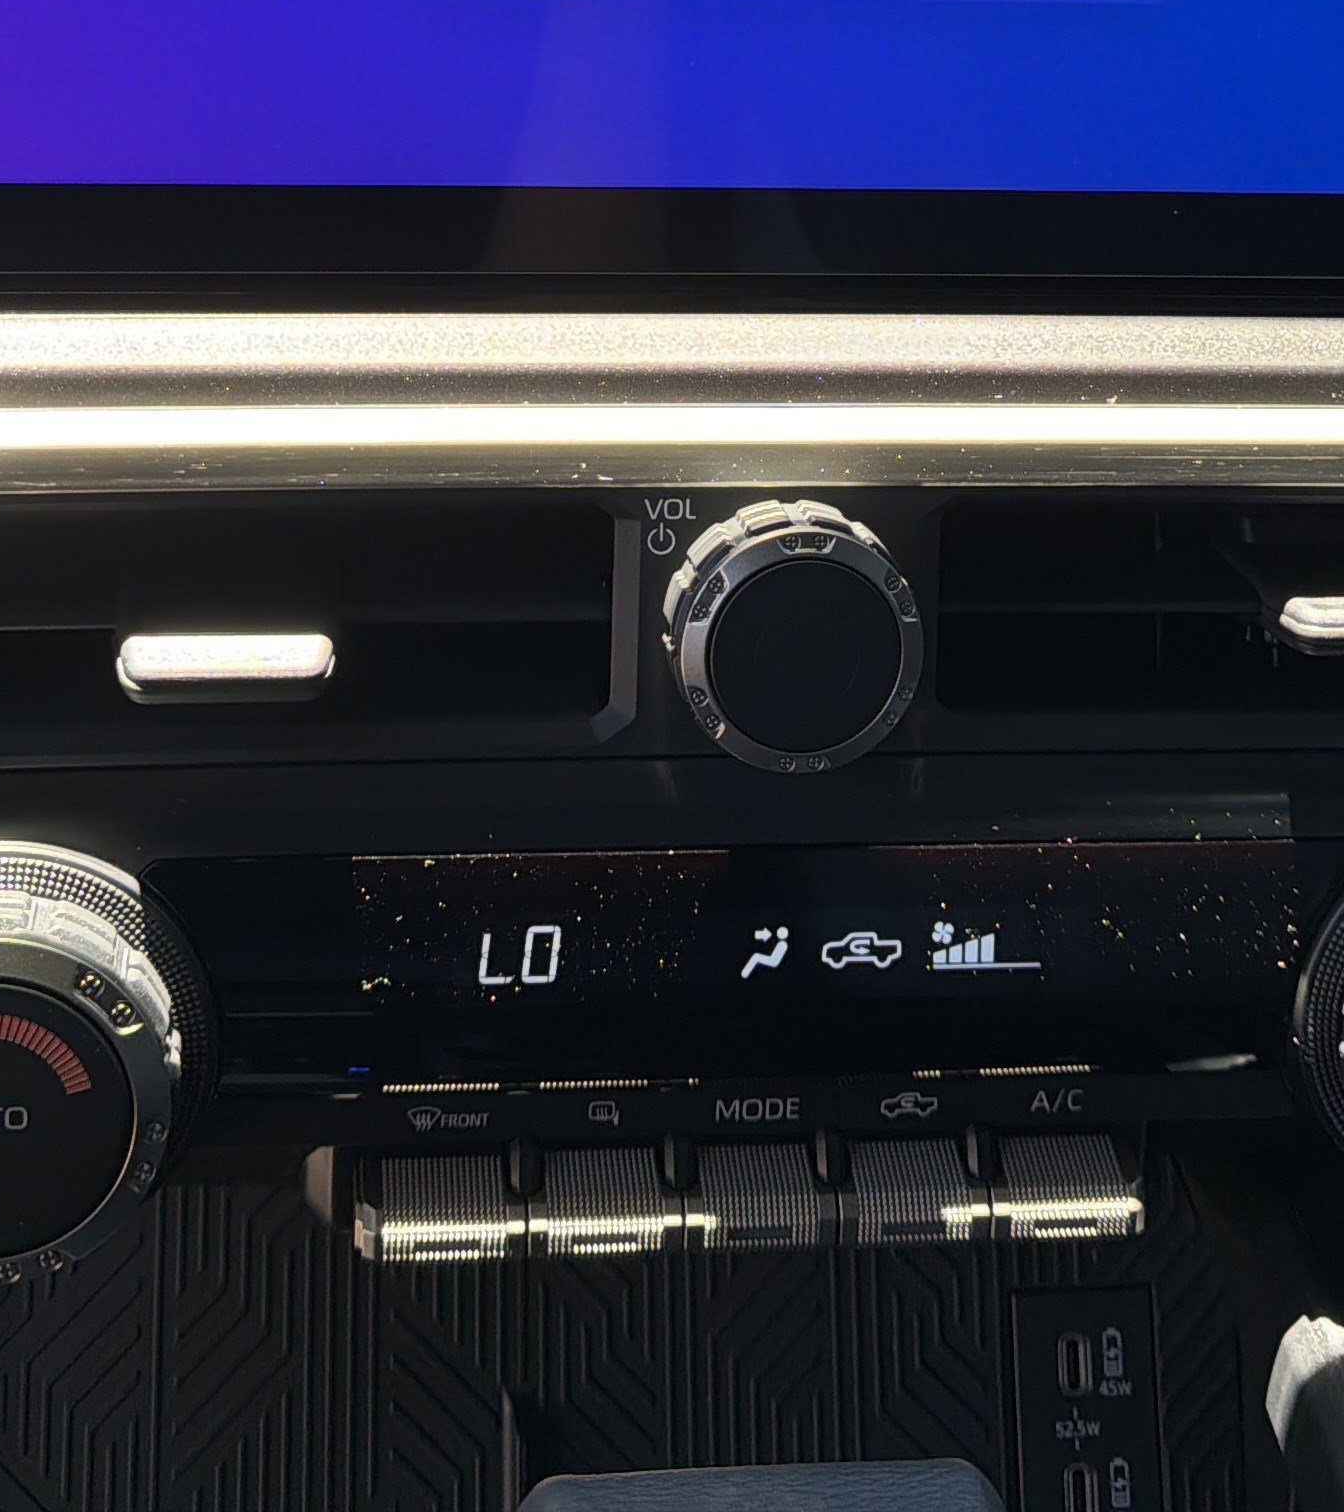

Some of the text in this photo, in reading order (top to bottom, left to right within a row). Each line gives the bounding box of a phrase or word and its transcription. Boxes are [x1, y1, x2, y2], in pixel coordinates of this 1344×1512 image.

[644, 498, 697, 520] VOL
[715, 1096, 801, 1123] MODE
[1031, 1090, 1084, 1115] A/C
[440, 1112, 491, 1129] FRONT
